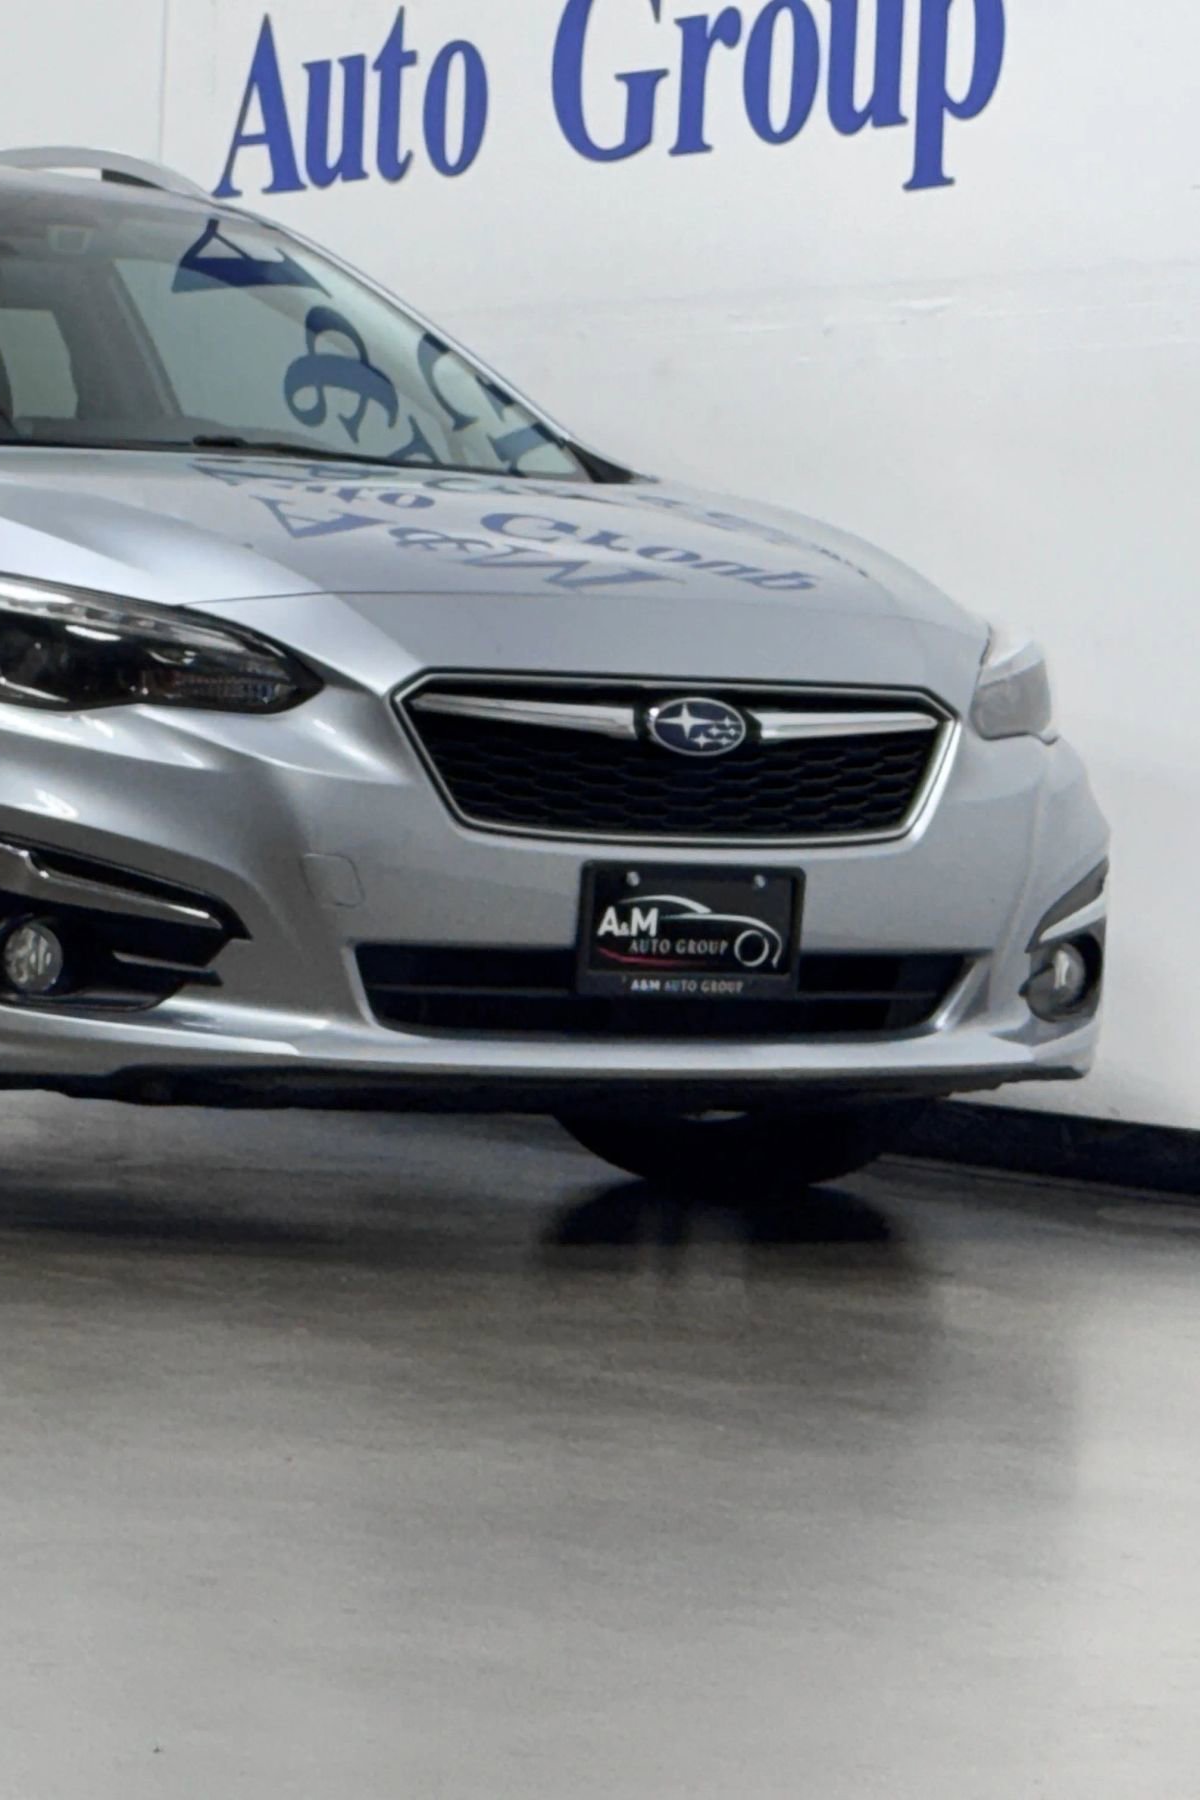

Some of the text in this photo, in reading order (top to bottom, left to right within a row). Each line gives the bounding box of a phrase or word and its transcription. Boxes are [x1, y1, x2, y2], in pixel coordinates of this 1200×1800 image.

[212, 0, 1006, 198] Auto Group
[597, 906, 659, 937] A&M
[629, 938, 729, 955] AUTO GROUP
[630, 979, 744, 993] A&M AUTO GROUP
